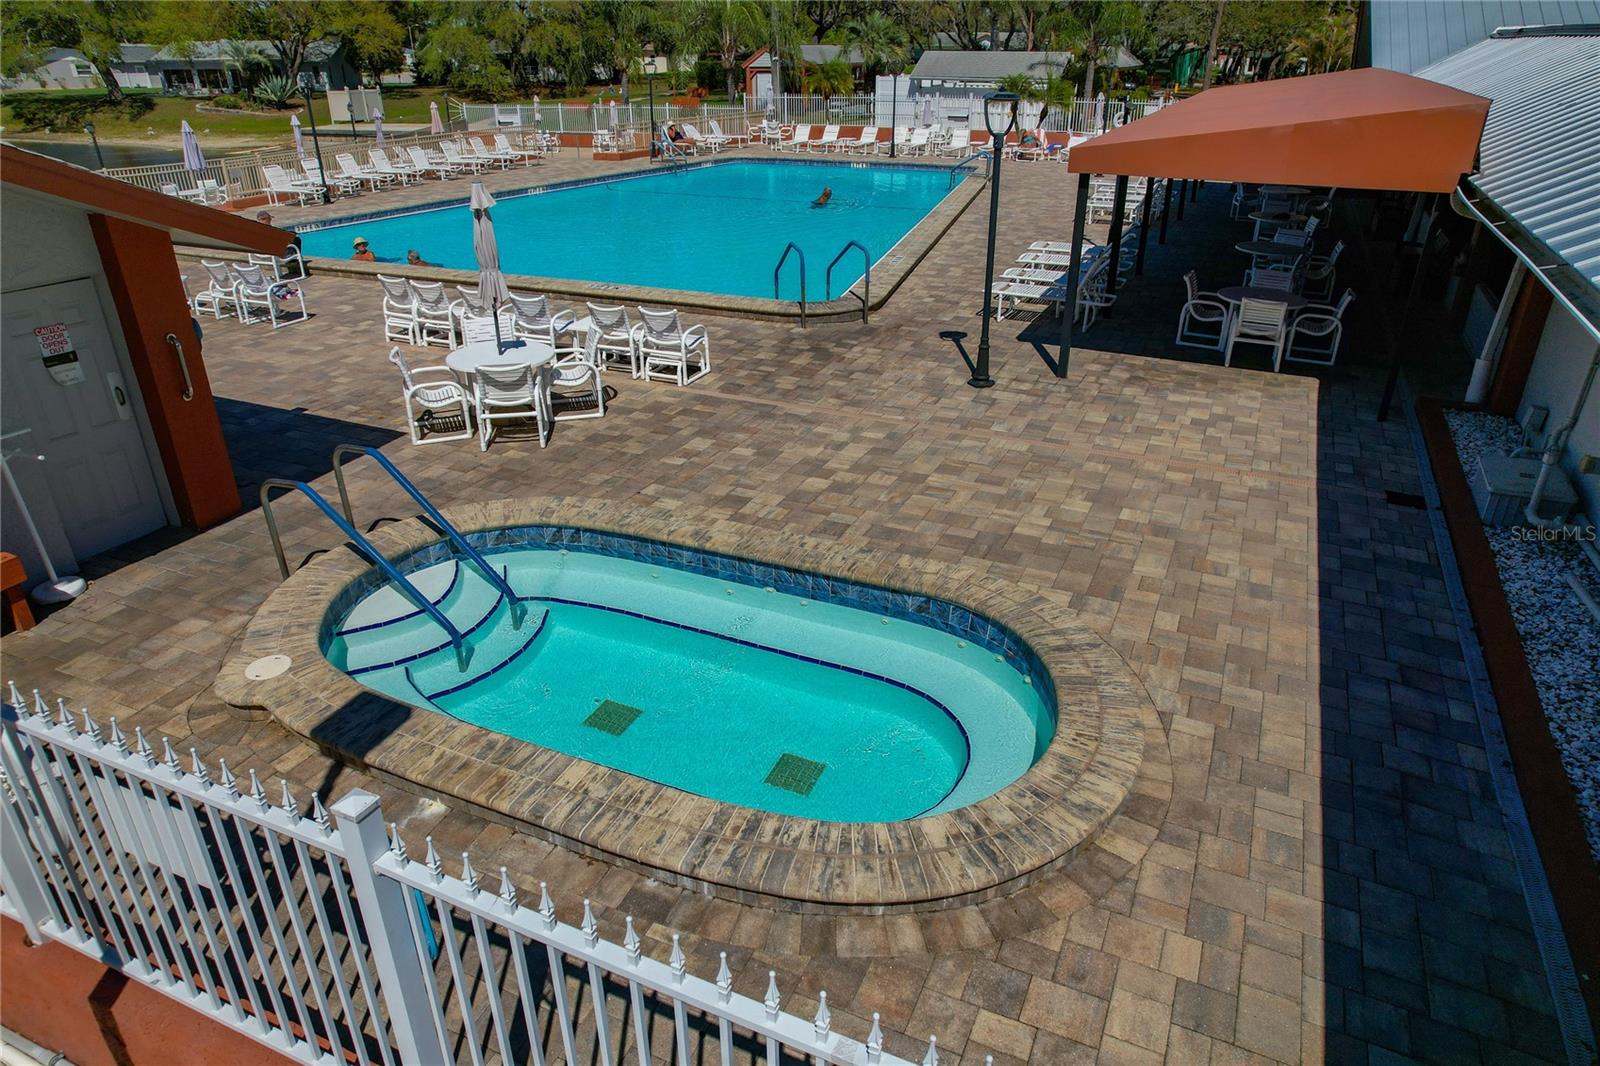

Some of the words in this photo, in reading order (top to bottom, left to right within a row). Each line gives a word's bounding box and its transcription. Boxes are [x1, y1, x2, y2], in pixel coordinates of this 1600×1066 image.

[35, 324, 66, 335] CAUTION
[42, 333, 64, 342] DOOR
[43, 339, 68, 349] OPENS
